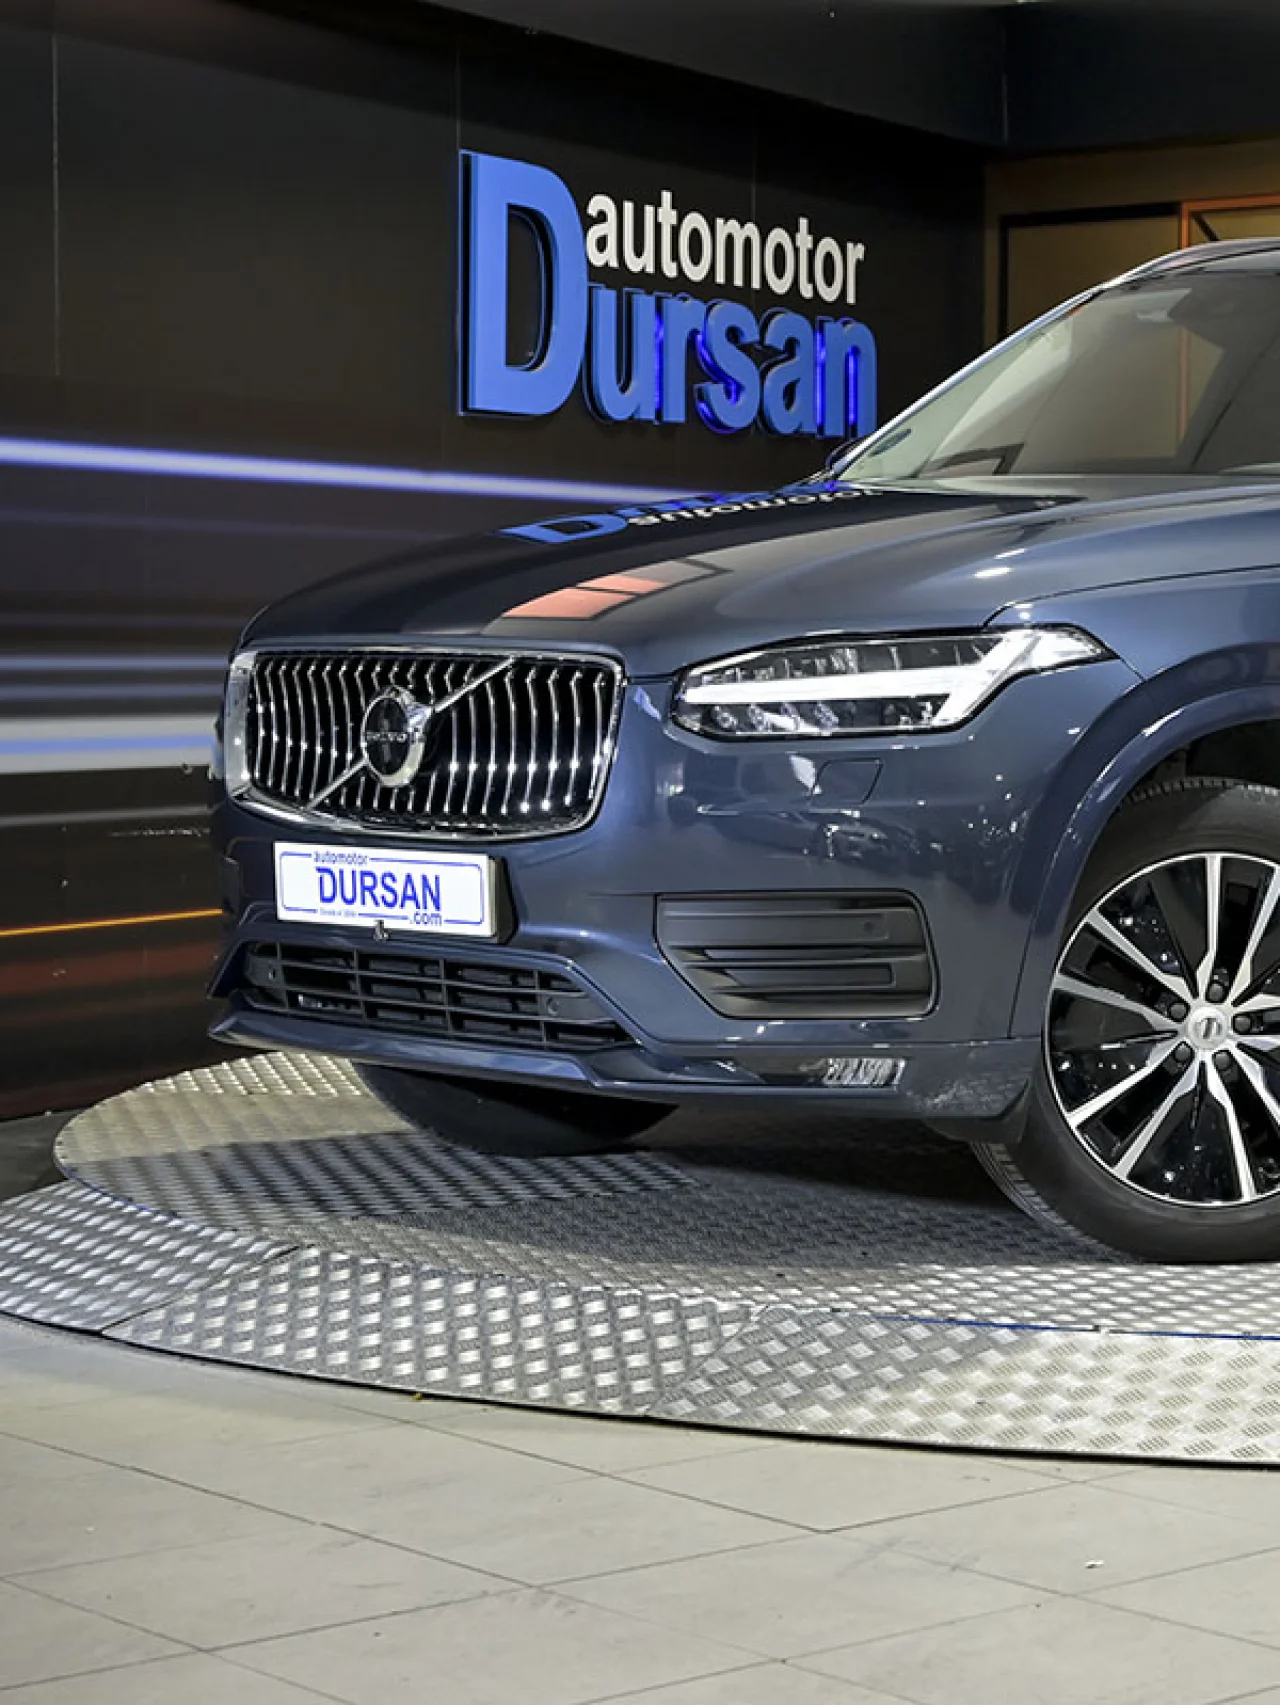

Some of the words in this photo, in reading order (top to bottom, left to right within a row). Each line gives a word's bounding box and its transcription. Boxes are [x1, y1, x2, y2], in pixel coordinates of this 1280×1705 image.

[585, 189, 866, 305] automotor
[458, 148, 878, 439] Dursan
[314, 850, 368, 867] automotor
[315, 866, 442, 912] DURSAN
